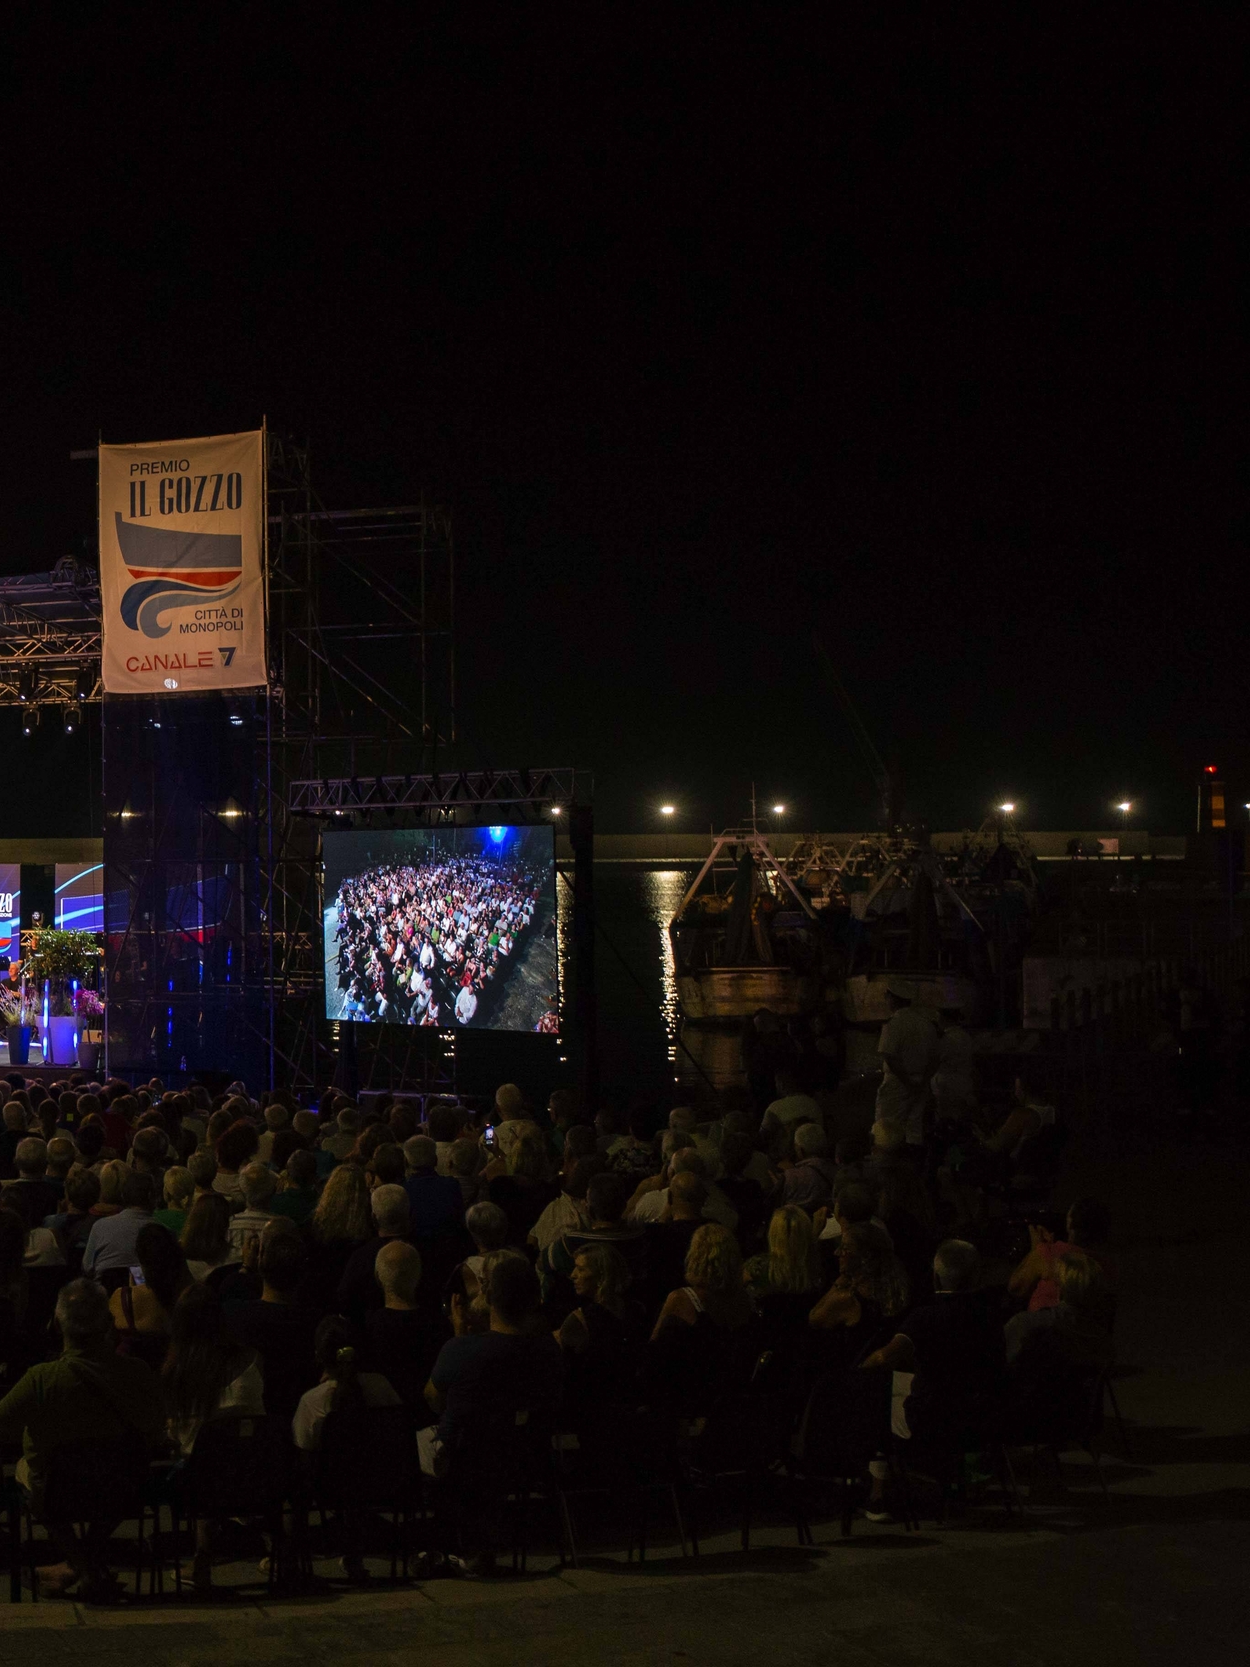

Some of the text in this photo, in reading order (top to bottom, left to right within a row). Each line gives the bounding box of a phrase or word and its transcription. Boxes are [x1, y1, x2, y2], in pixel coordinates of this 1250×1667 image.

[130, 459, 190, 476] PREMIO
[129, 472, 242, 518] IL GOZZO
[194, 606, 243, 620] CITTÀ DI
[179, 621, 243, 633] MONOPOLI
[126, 647, 236, 672] CANALE 7
